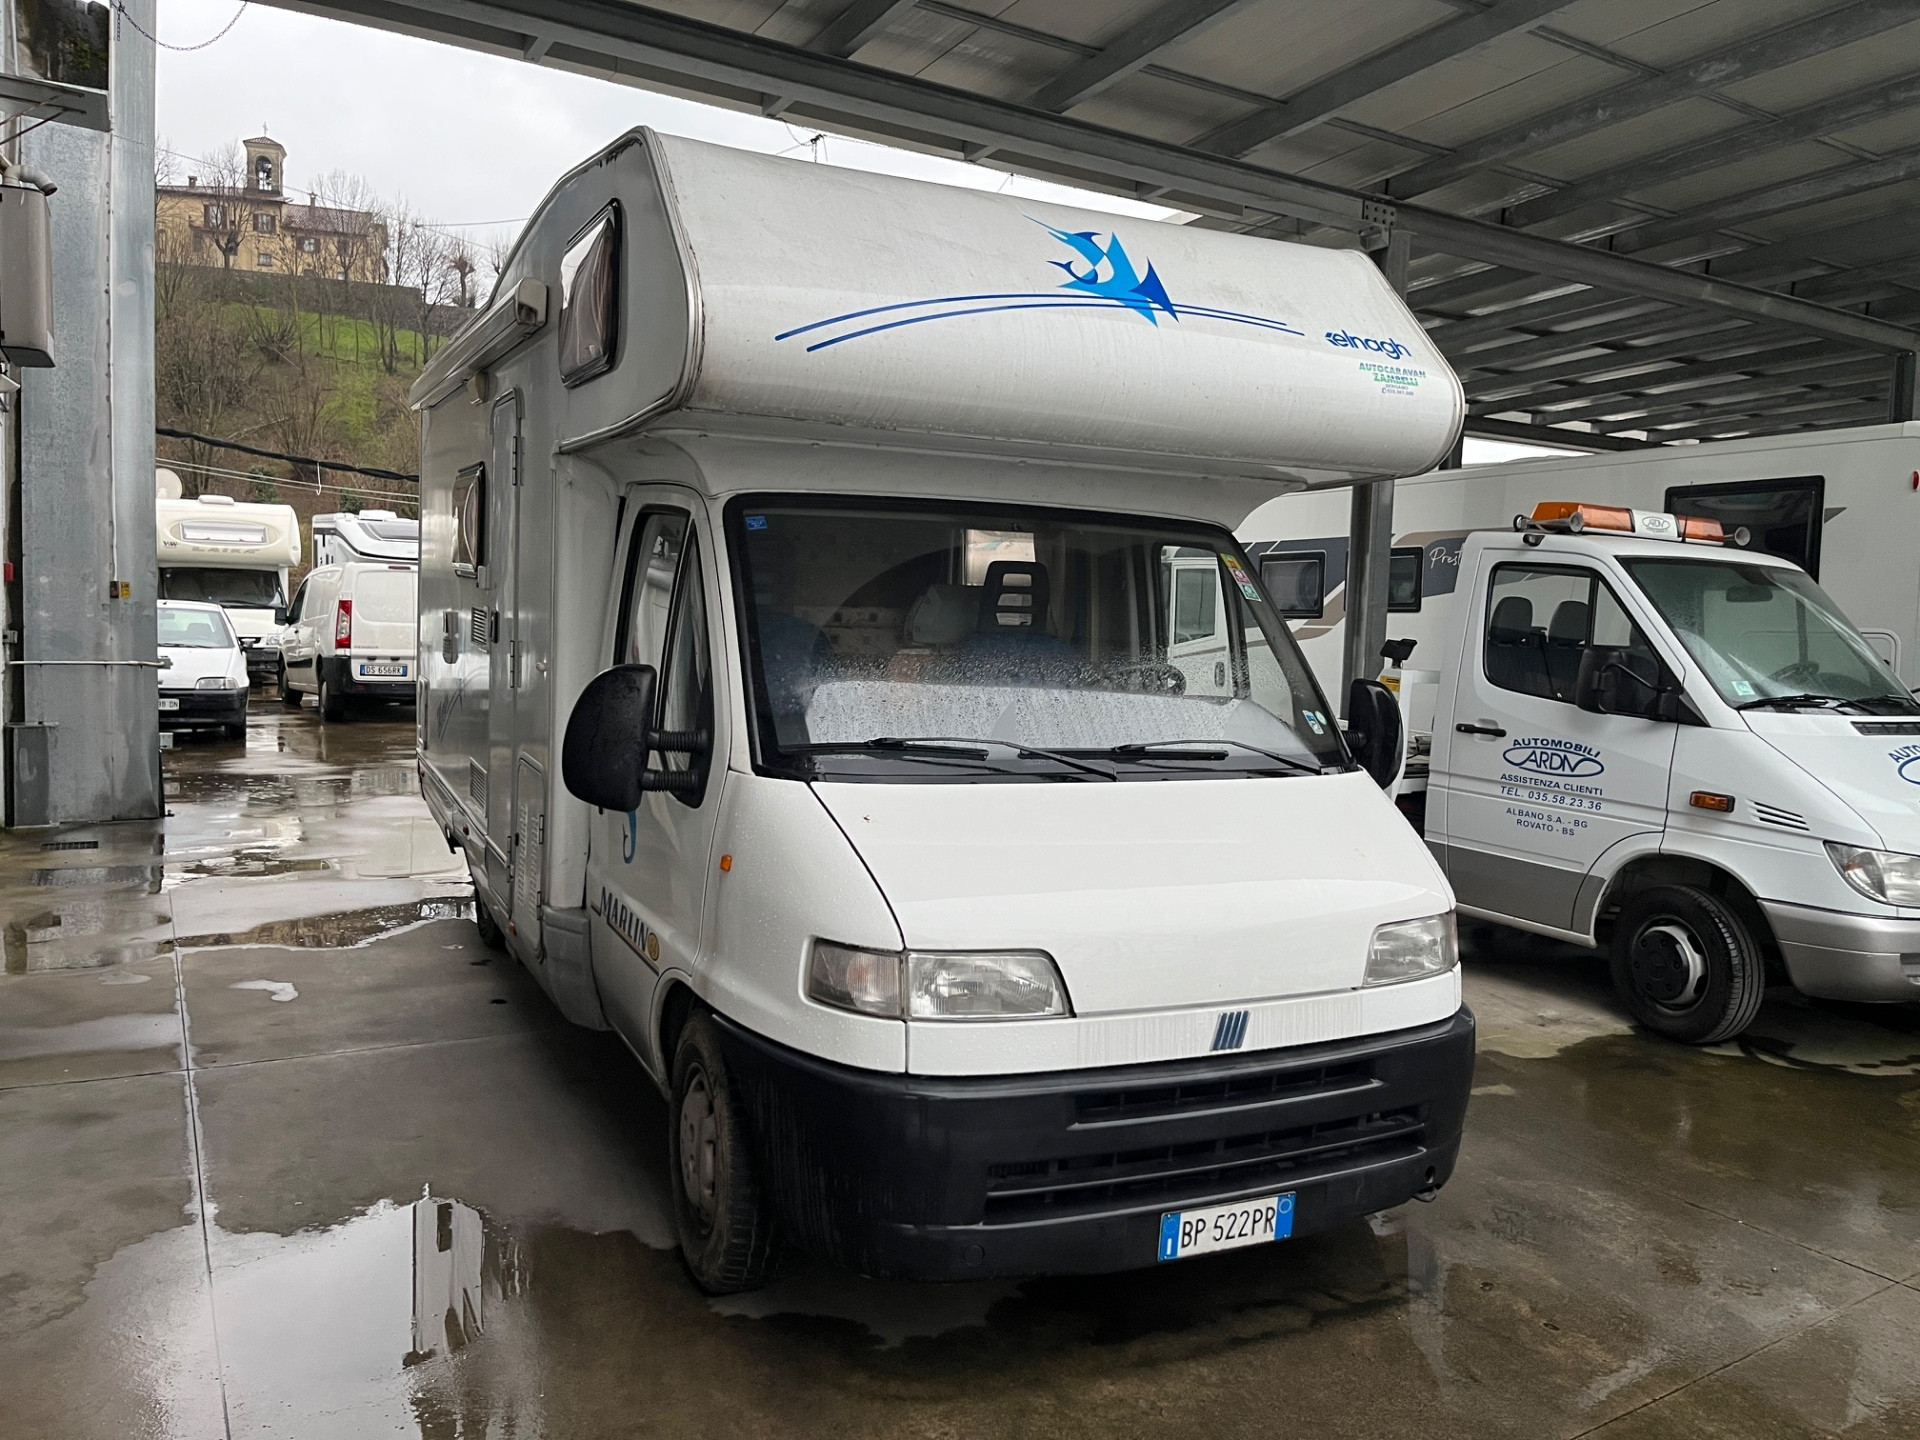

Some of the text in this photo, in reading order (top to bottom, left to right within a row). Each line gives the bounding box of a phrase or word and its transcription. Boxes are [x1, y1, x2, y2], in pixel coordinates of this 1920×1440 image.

[366, 666, 376, 674] DS
[1513, 738, 1600, 758] AUTOMOBILI
[1500, 773, 1603, 796] ASSISTENZA CLIENTI
[1500, 786, 1602, 811] TEL. 035.58.23.36
[1506, 807, 1544, 820] ALBANO
[1573, 819, 1588, 829] BG
[1516, 818, 1554, 832] ROVATO
[1562, 827, 1575, 836] BS
[600, 886, 648, 952] MARLIN
[1181, 1206, 1276, 1248] BP 522PR
